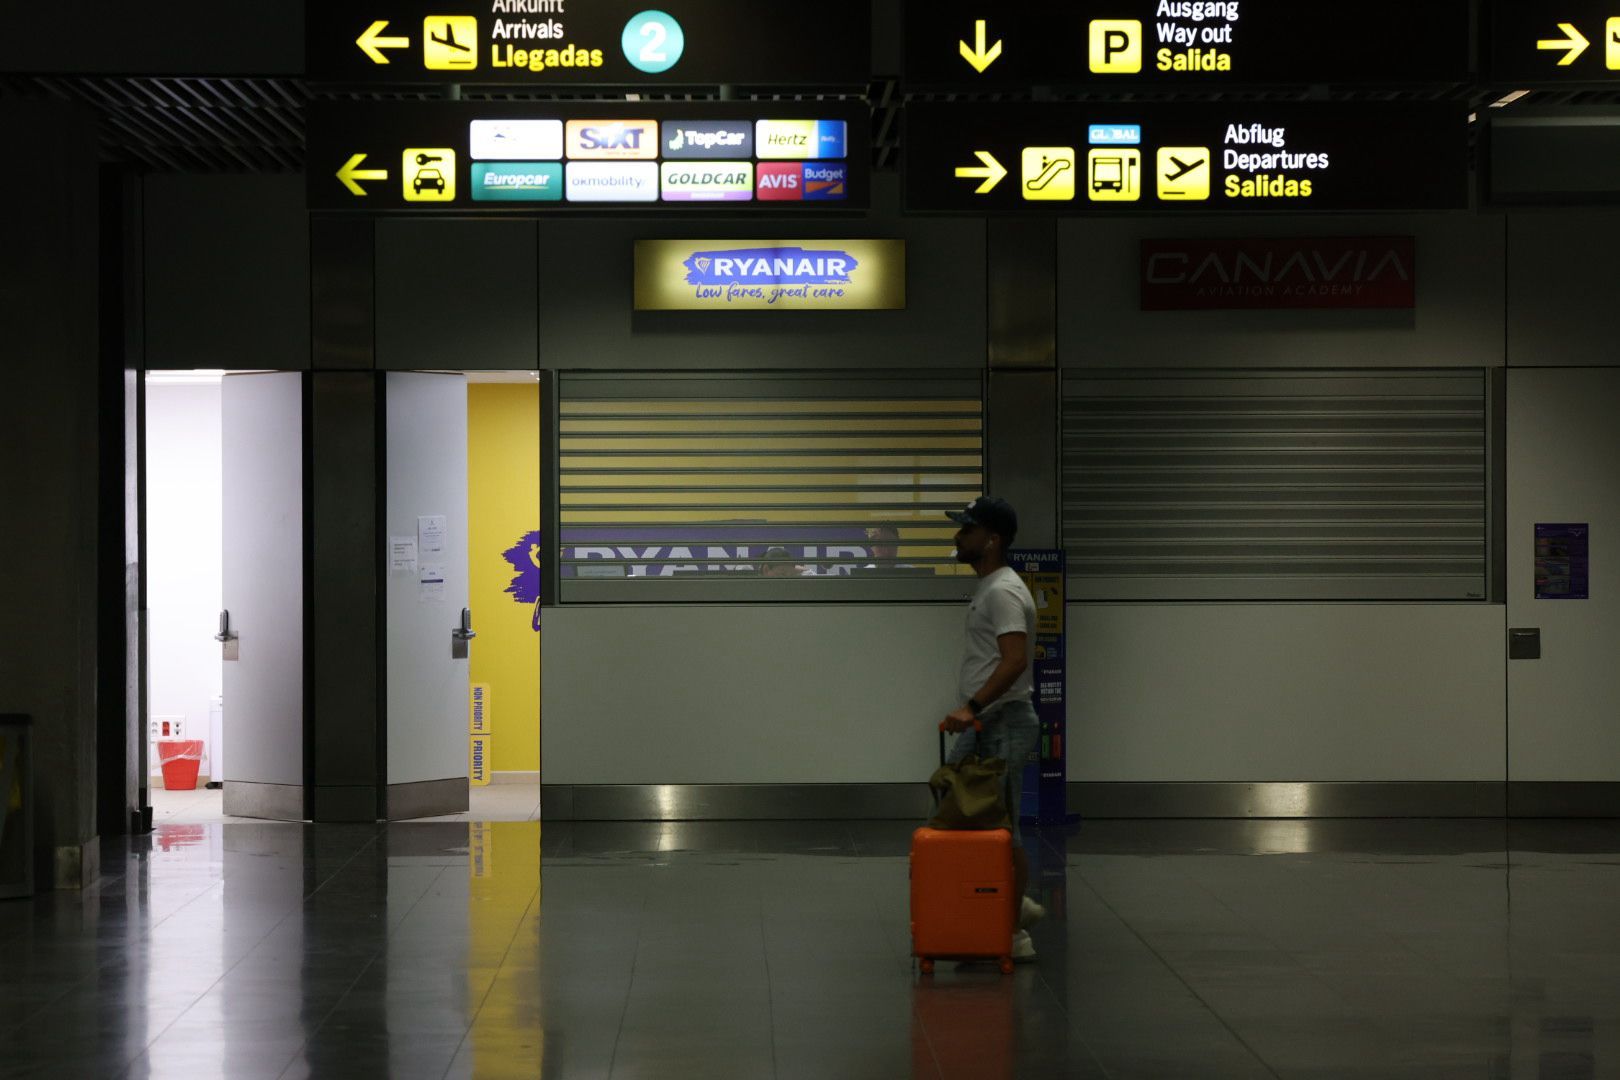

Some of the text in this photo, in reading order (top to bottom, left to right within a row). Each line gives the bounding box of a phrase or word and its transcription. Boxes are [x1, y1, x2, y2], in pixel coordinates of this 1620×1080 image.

[1156, 0, 1239, 21] Ausgang
[491, 18, 564, 39] Arrivals
[1156, 22, 1233, 47] Way out
[639, 21, 667, 62] 2
[491, 43, 604, 72] Llegadas
[1156, 48, 1231, 71] Salida
[684, 130, 745, 149] TopCar
[767, 133, 808, 146] Hertz
[1091, 128, 1139, 140] GLBAL
[1224, 124, 1285, 147] Abflug
[1223, 149, 1330, 172] Departures
[483, 172, 550, 189] Europcar
[668, 172, 747, 185] GOLDCAR
[759, 174, 798, 189] AVIS
[804, 168, 844, 182] Budget
[1224, 174, 1313, 197] Salidas
[714, 258, 848, 276] RYANAIR
[1146, 250, 1409, 284] CANAVIA
[696, 280, 844, 304] Low fares, great care
[574, 546, 867, 577] RYANIR
[474, 740, 483, 781] PRIORITY
